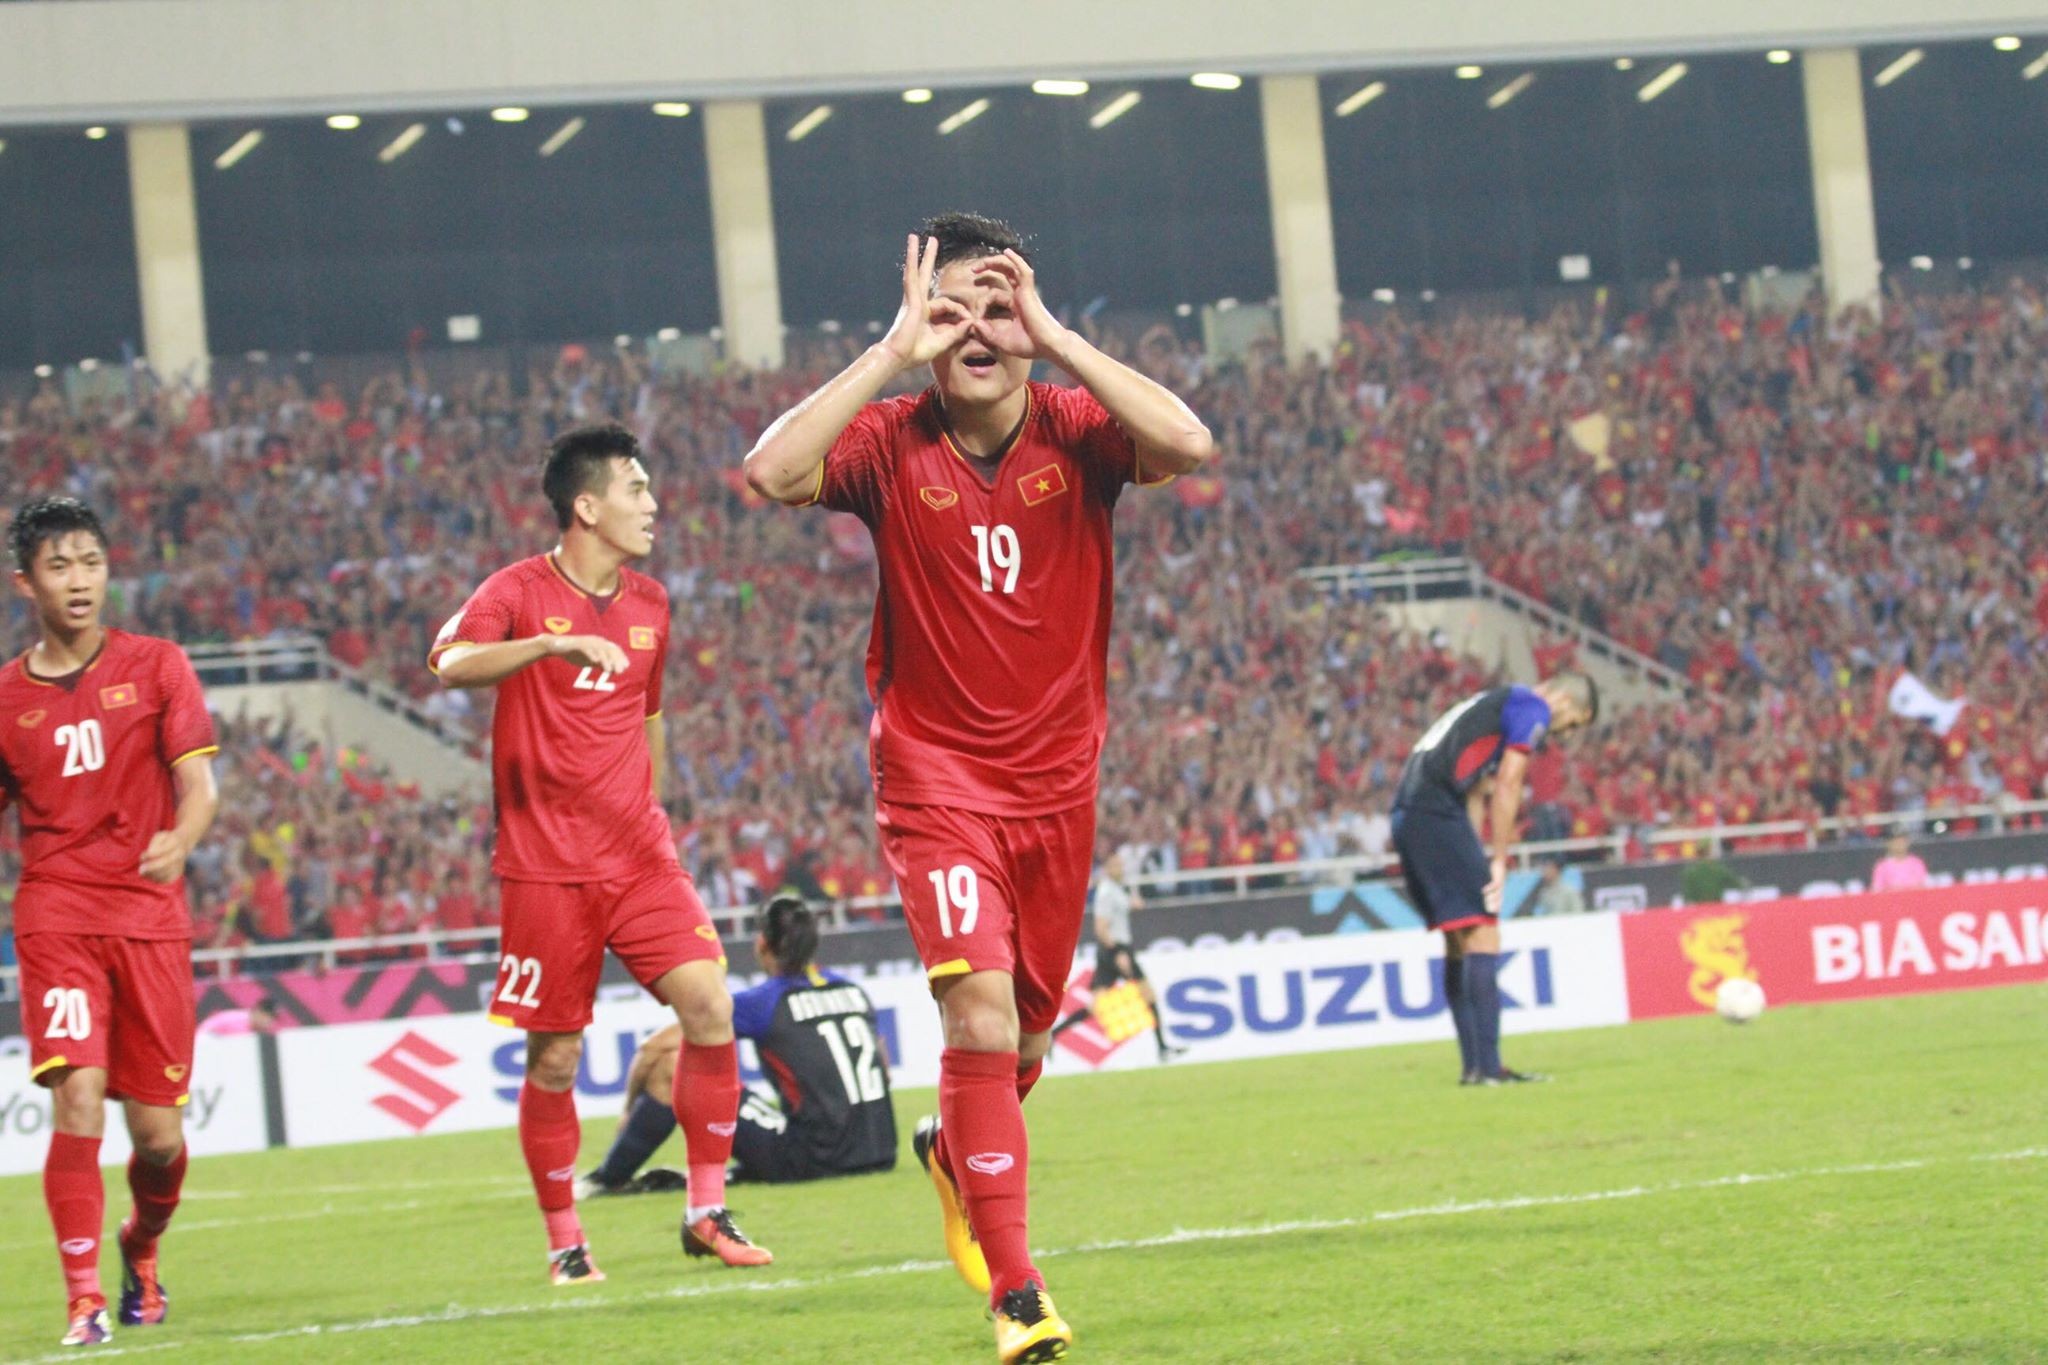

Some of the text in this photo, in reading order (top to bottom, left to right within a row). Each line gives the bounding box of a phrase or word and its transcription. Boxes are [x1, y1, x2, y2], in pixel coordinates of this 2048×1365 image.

[970, 523, 1021, 594] 19
[54, 718, 105, 778] 20
[928, 864, 980, 938] 19
[498, 953, 542, 1008] 22
[1811, 907, 2048, 984] BIA SAI
[43, 986, 92, 1041] 20
[816, 1015, 885, 1105] 12
